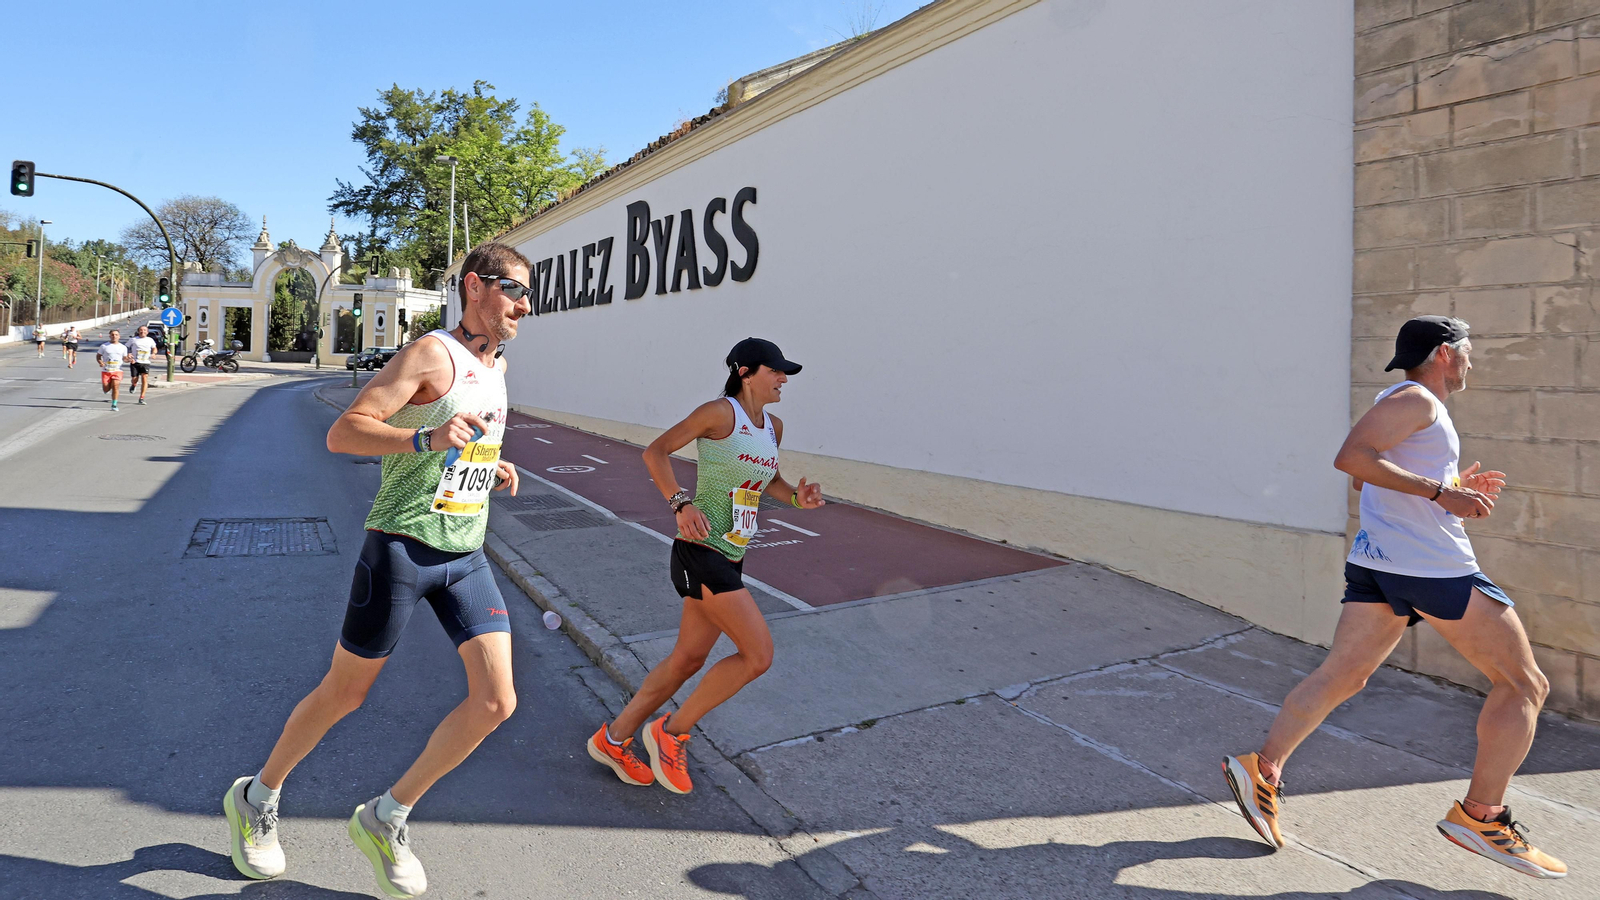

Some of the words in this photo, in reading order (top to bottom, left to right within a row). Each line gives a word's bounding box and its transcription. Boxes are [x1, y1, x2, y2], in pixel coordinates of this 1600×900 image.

[522, 236, 614, 317] NZALEZ
[624, 186, 759, 301] BYASS
[737, 453, 779, 470] marat
[746, 493, 759, 502] Sherr
[740, 509, 757, 530] 107
